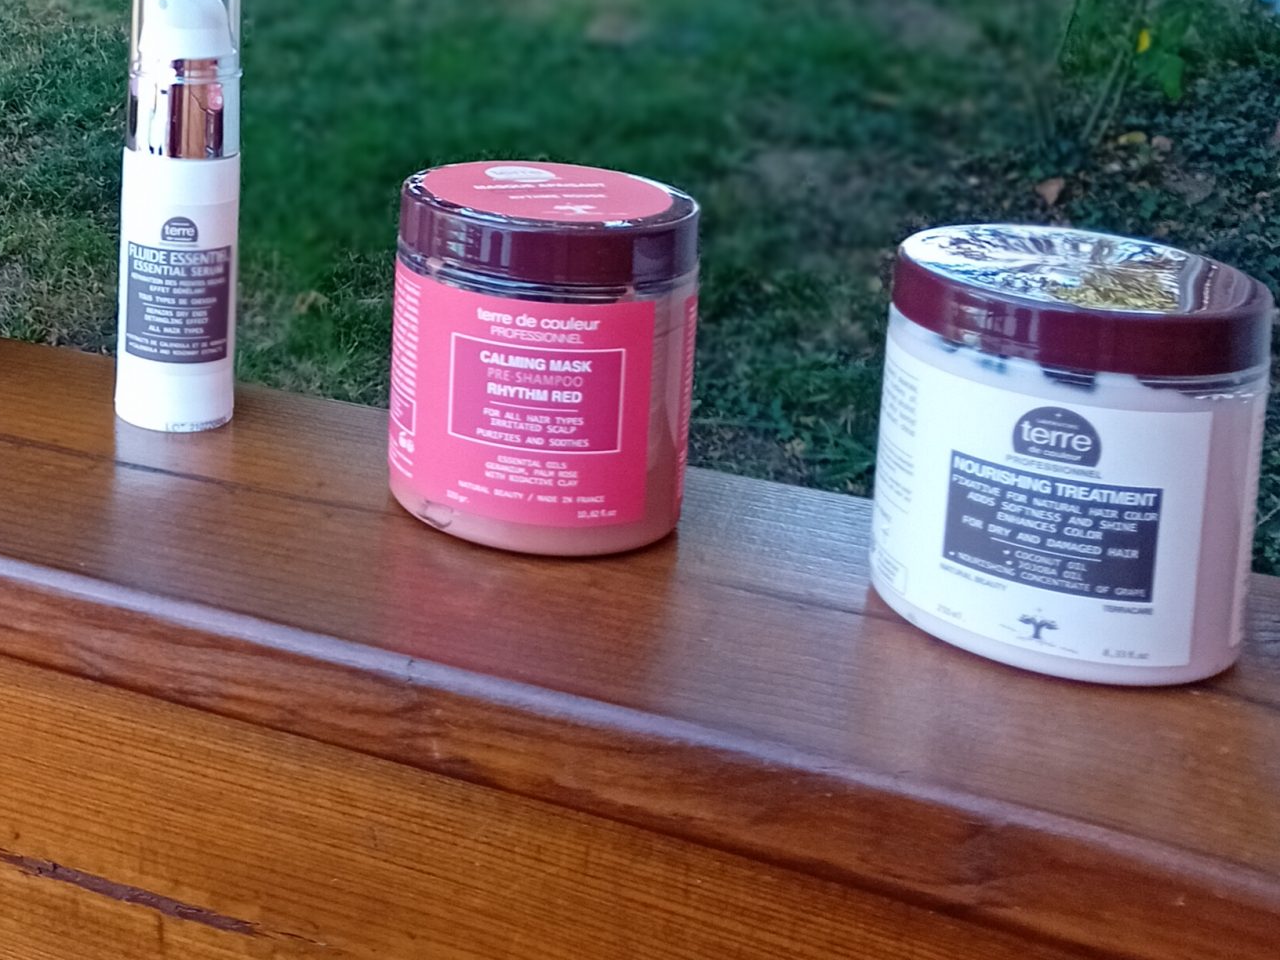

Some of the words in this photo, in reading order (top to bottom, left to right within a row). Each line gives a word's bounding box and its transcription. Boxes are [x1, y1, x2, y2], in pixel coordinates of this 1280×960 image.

[165, 226, 195, 237] terre
[129, 243, 167, 264] FLUIDE
[170, 250, 230, 266] ESSENTIEL
[134, 260, 187, 276] ESSENTIAL
[191, 266, 223, 277] SERUM
[477, 307, 512, 325] terre
[515, 313, 537, 327] de
[540, 317, 600, 330] couleur
[490, 325, 584, 344] PROFESSIONNEL
[480, 350, 546, 371] CALMING
[549, 359, 592, 373] MASK
[487, 382, 548, 401] RHYTHM
[552, 390, 582, 403] RED
[483, 407, 500, 417] FOR
[504, 410, 521, 421] ALL
[526, 414, 550, 424] HAIR
[556, 416, 584, 426] TYPES
[490, 418, 542, 432] IRRITATED
[547, 424, 577, 434] SCALP
[476, 427, 520, 443] PURIFIES
[525, 436, 544, 445] AND
[549, 438, 589, 447] SOOTHES
[1021, 420, 1092, 452] terre
[1006, 454, 1101, 479] PROFESSIONNEL
[1043, 449, 1081, 461] couleur
[953, 455, 1052, 494] NOURISHING
[1055, 482, 1157, 506] TREATMENT
[952, 474, 1001, 497] FIXATIVE
[1006, 491, 1028, 503] FOR
[1033, 496, 1082, 514] NATURAL
[1088, 507, 1119, 519] HAIR
[1124, 511, 1159, 521] COLOR
[968, 492, 996, 507] ADDS
[1001, 501, 1062, 522] SOFTNESS
[1068, 516, 1093, 528] AND
[1099, 520, 1138, 533] SHINE
[962, 515, 984, 529] FOR
[987, 524, 1012, 537] DRY
[1016, 532, 1041, 544] AND
[1046, 538, 1102, 556] DAMAGED
[1107, 547, 1139, 559] HAIR
[997, 512, 1057, 533] ENHANCES
[1063, 527, 1103, 540] COLOR
[1014, 550, 1063, 567] COCONUT
[1067, 561, 1088, 572] OIL
[1020, 571, 1091, 592] CONCENTRATE
[1095, 585, 1110, 594] OF
[1062, 571, 1084, 581] OIL
